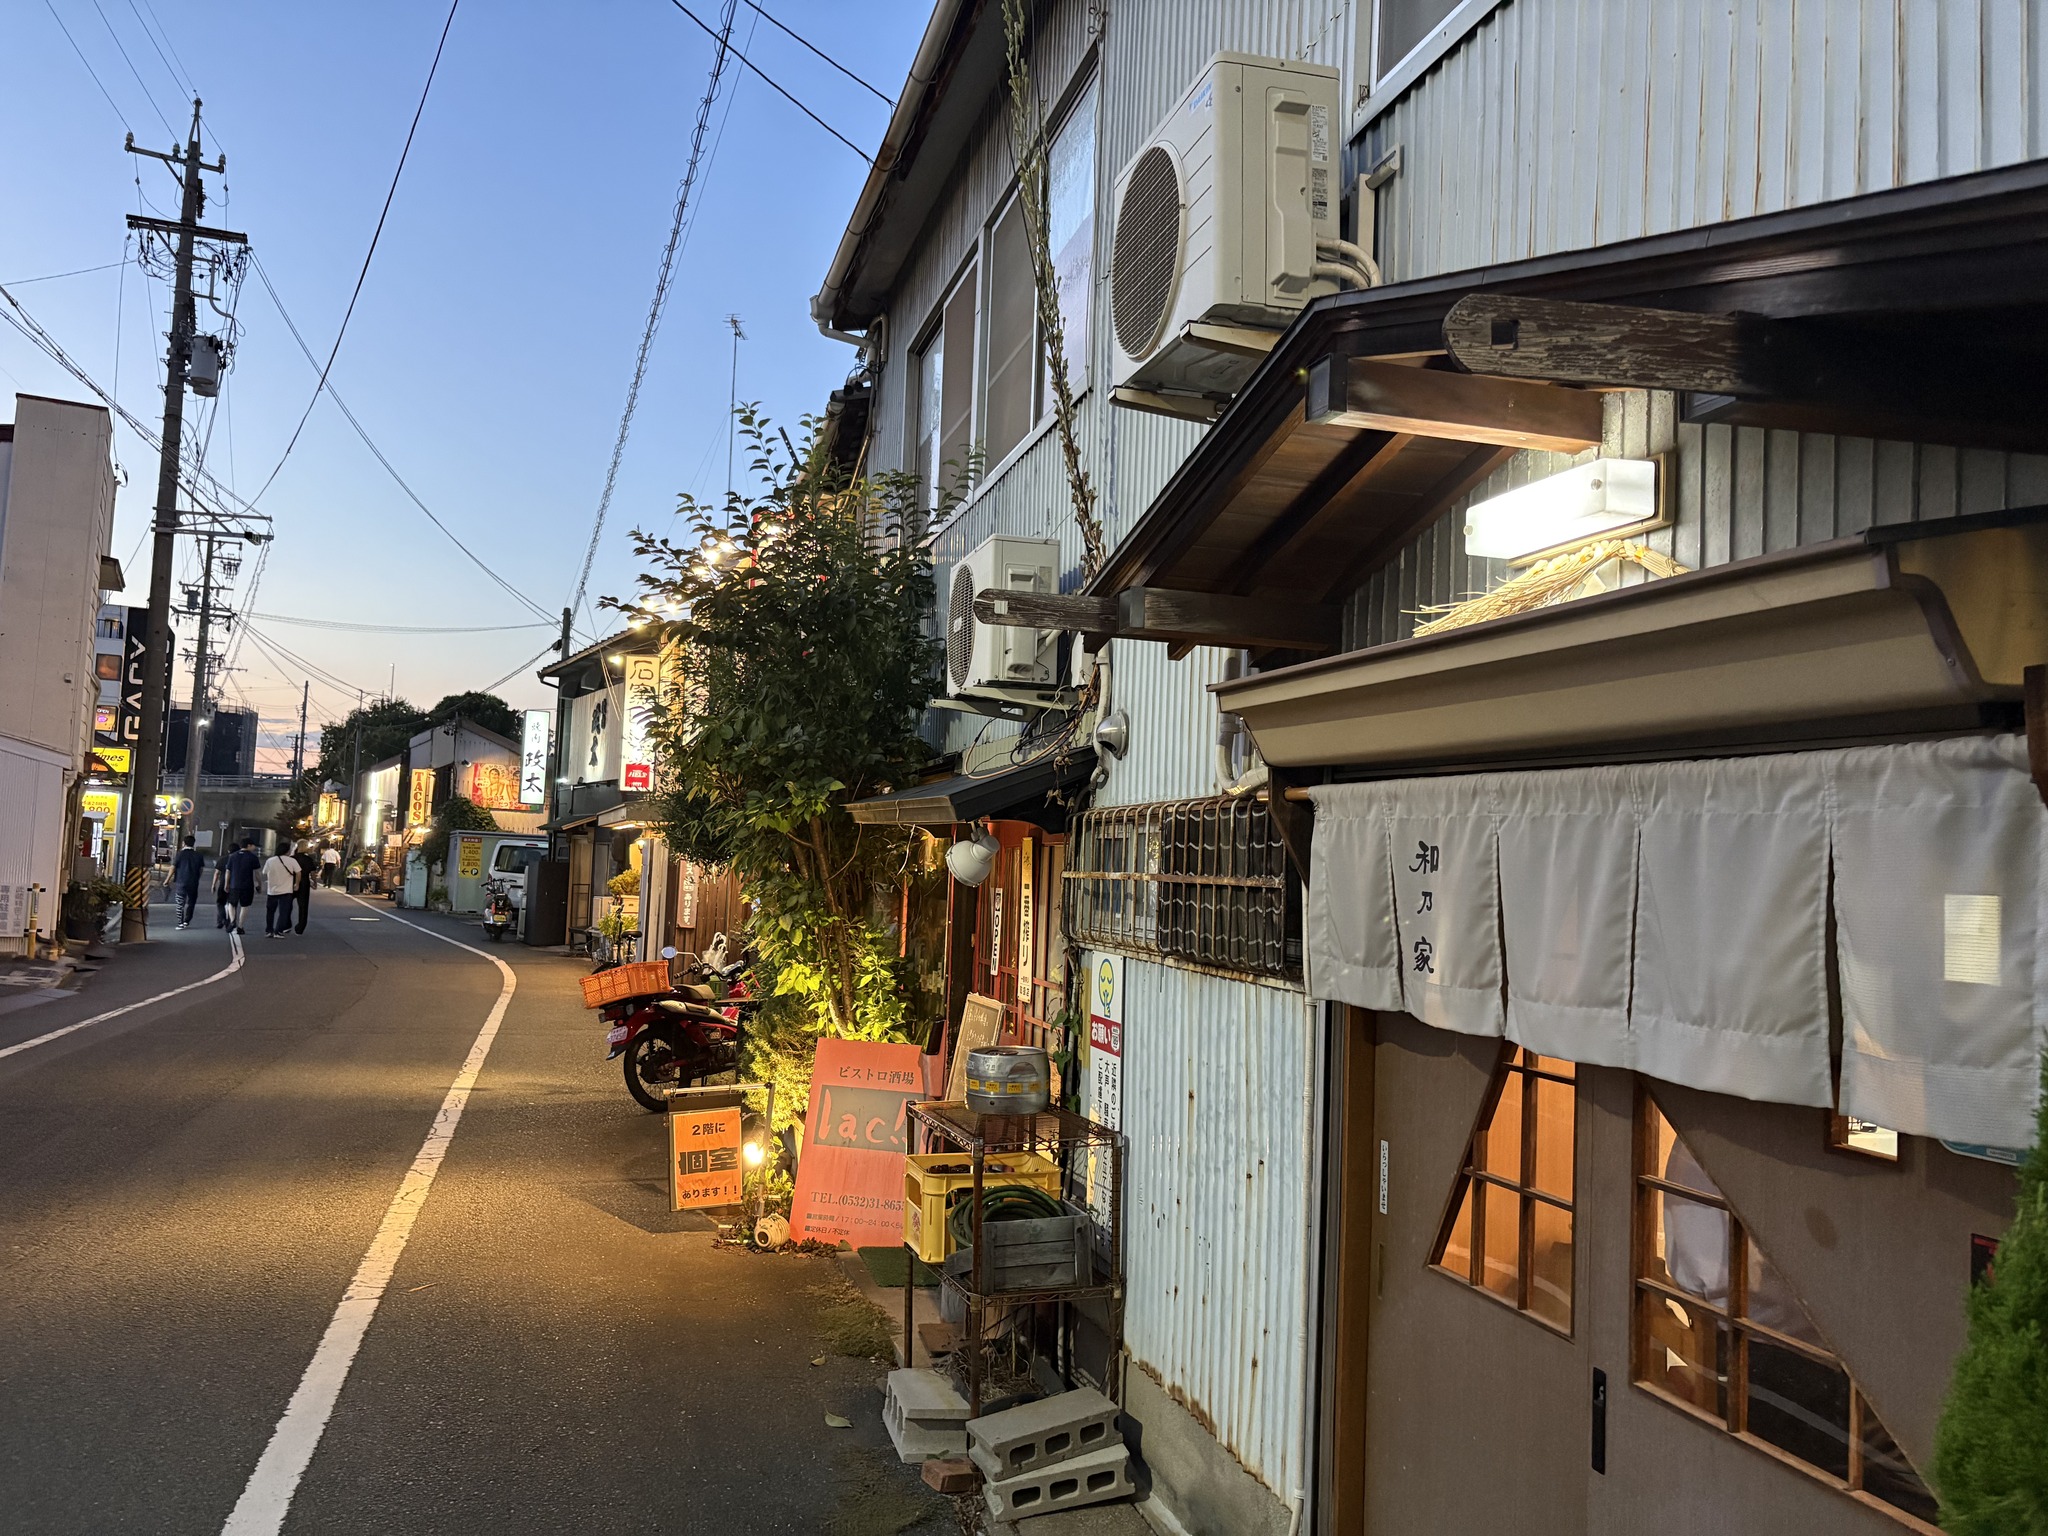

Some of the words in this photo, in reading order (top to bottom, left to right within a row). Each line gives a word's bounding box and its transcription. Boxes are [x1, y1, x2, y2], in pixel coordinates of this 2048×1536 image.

[522, 749, 545, 793] 政太
[412, 771, 424, 821] TACOS
[1409, 840, 1440, 975] 和乃家
[992, 914, 1000, 971] OPEN
[1091, 1020, 1111, 1045] お願い
[838, 1066, 915, 1086] ビストロ酒場
[691, 1121, 726, 1136] 2階に
[679, 1145, 738, 1176] 個室
